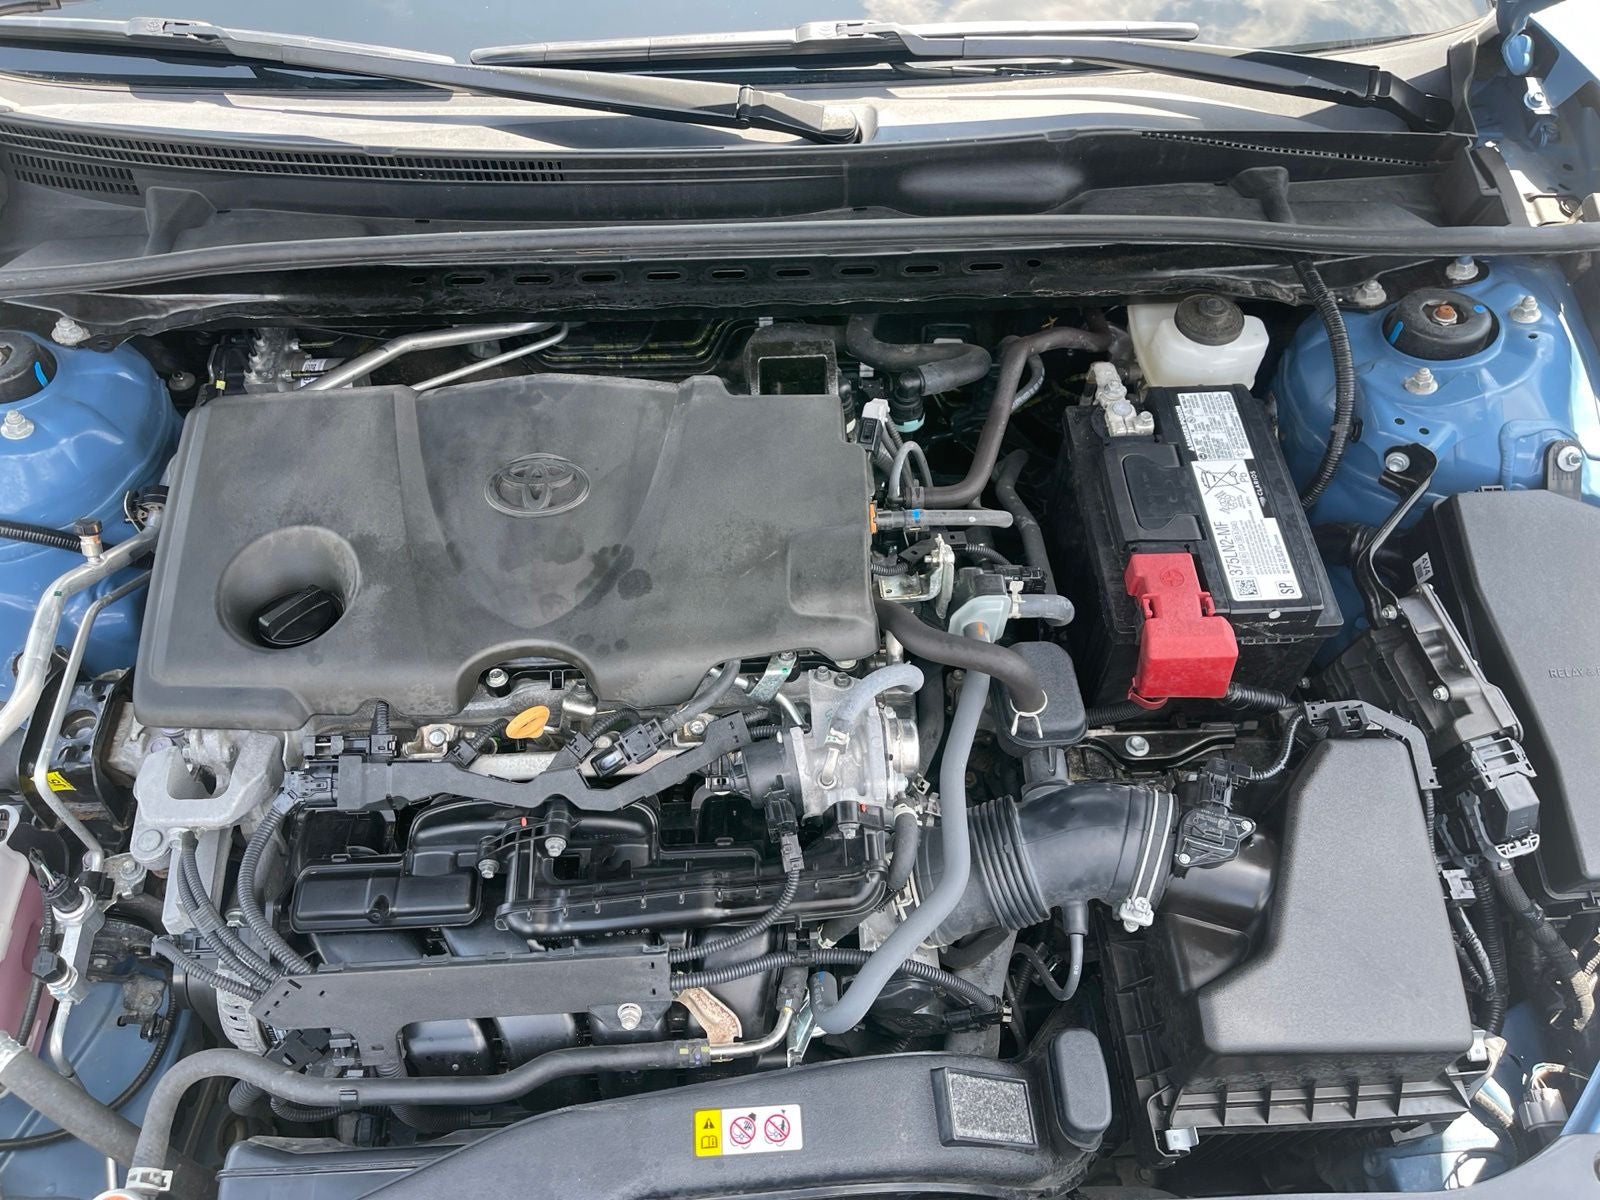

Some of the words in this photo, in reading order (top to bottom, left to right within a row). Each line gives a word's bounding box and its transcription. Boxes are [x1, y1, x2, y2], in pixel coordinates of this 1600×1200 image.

[1251, 470, 1265, 500] CLARIOS
[1214, 521, 1243, 575] 375LN2-MF
[1280, 582, 1295, 594] SP
[1548, 667, 1583, 679] RELAY
